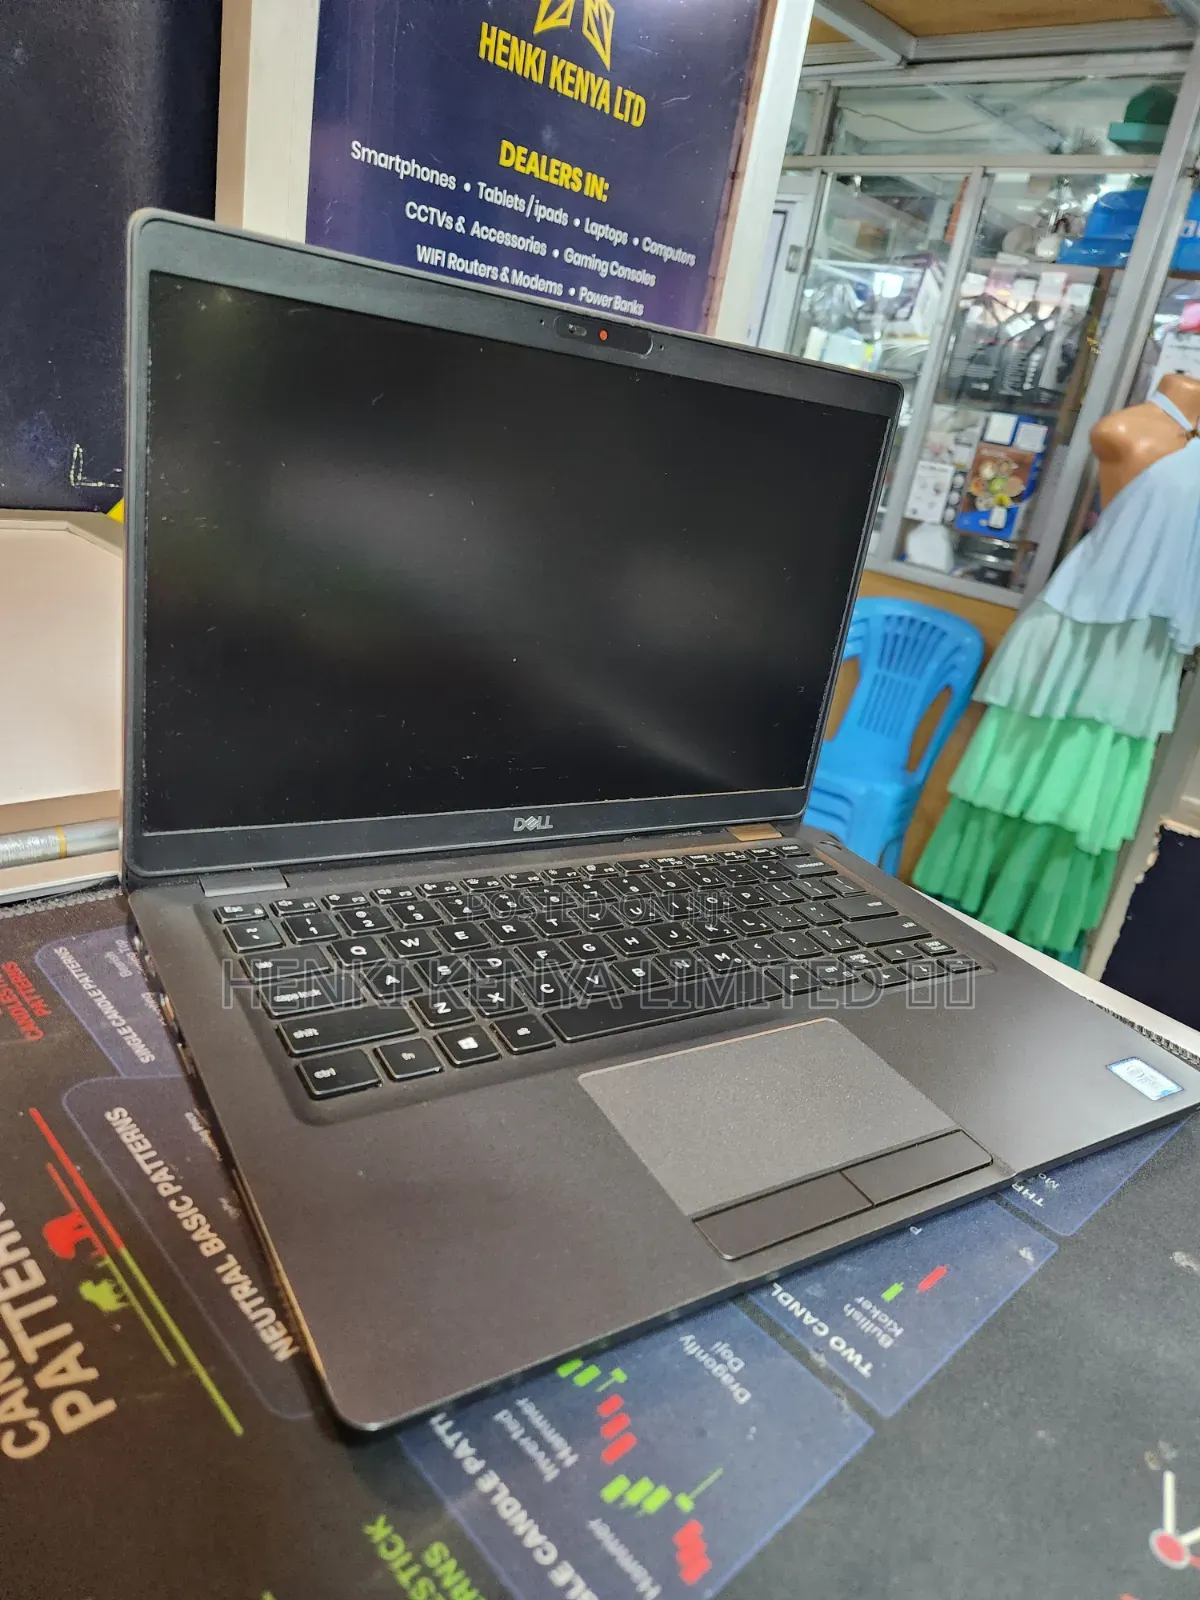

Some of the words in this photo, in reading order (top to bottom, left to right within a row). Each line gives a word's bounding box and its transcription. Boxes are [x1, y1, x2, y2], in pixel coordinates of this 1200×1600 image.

[478, 22, 546, 84] HENKI
[549, 55, 610, 114] KENYA
[613, 86, 646, 127] LTD
[499, 140, 582, 192] DEALERS
[584, 172, 609, 202] IN:
[351, 141, 456, 190] Smartphones
[584, 217, 628, 246] Laptops
[642, 237, 696, 266] Computers
[405, 201, 453, 230] CCTVs
[455, 216, 466, 234] &
[470, 221, 547, 257] Accessories
[564, 247, 609, 278] Gaming
[610, 261, 656, 287] Consoles
[448, 252, 498, 281] Routers
[500, 266, 510, 284] &
[511, 269, 563, 296] Modems
[579, 286, 614, 309] Power
[613, 295, 644, 316] Banks
[513, 815, 553, 832] DELL
[629, 906, 642, 915] U
[546, 918, 559, 926] T
[742, 918, 755, 926] L
[501, 924, 516, 934] R
[704, 924, 719, 933] K
[454, 930, 470, 941] E
[623, 936, 640, 946] H
[400, 937, 419, 948] W
[582, 943, 596, 952] G
[350, 945, 367, 956] Q
[536, 950, 548, 960] F
[486, 957, 502, 967] D
[714, 952, 731, 962] M
[54, 946, 97, 990] PATTERNS
[674, 959, 690, 969] N
[436, 965, 452, 976] S
[631, 968, 646, 977] B
[385, 974, 400, 985] A
[586, 974, 599, 985] V
[540, 983, 554, 993] C
[487, 992, 505, 1004] X
[87, 988, 126, 1027] CANDLE
[434, 1002, 451, 1014] Z
[116, 1025, 156, 1064] SINGLE
[104, 1106, 183, 1198] PATTERNS
[168, 1195, 227, 1258] BASIC
[215, 1254, 300, 1362] NEUTRAL
[771, 1282, 829, 1338] CANDL
[854, 1296, 905, 1339] Kicker
[843, 1303, 895, 1350] Bullish
[709, 1341, 745, 1374] Doji
[829, 1335, 874, 1379] TWO
[679, 1334, 752, 1405] Dragonfly
[475, 1468, 558, 1566] CANDLE
